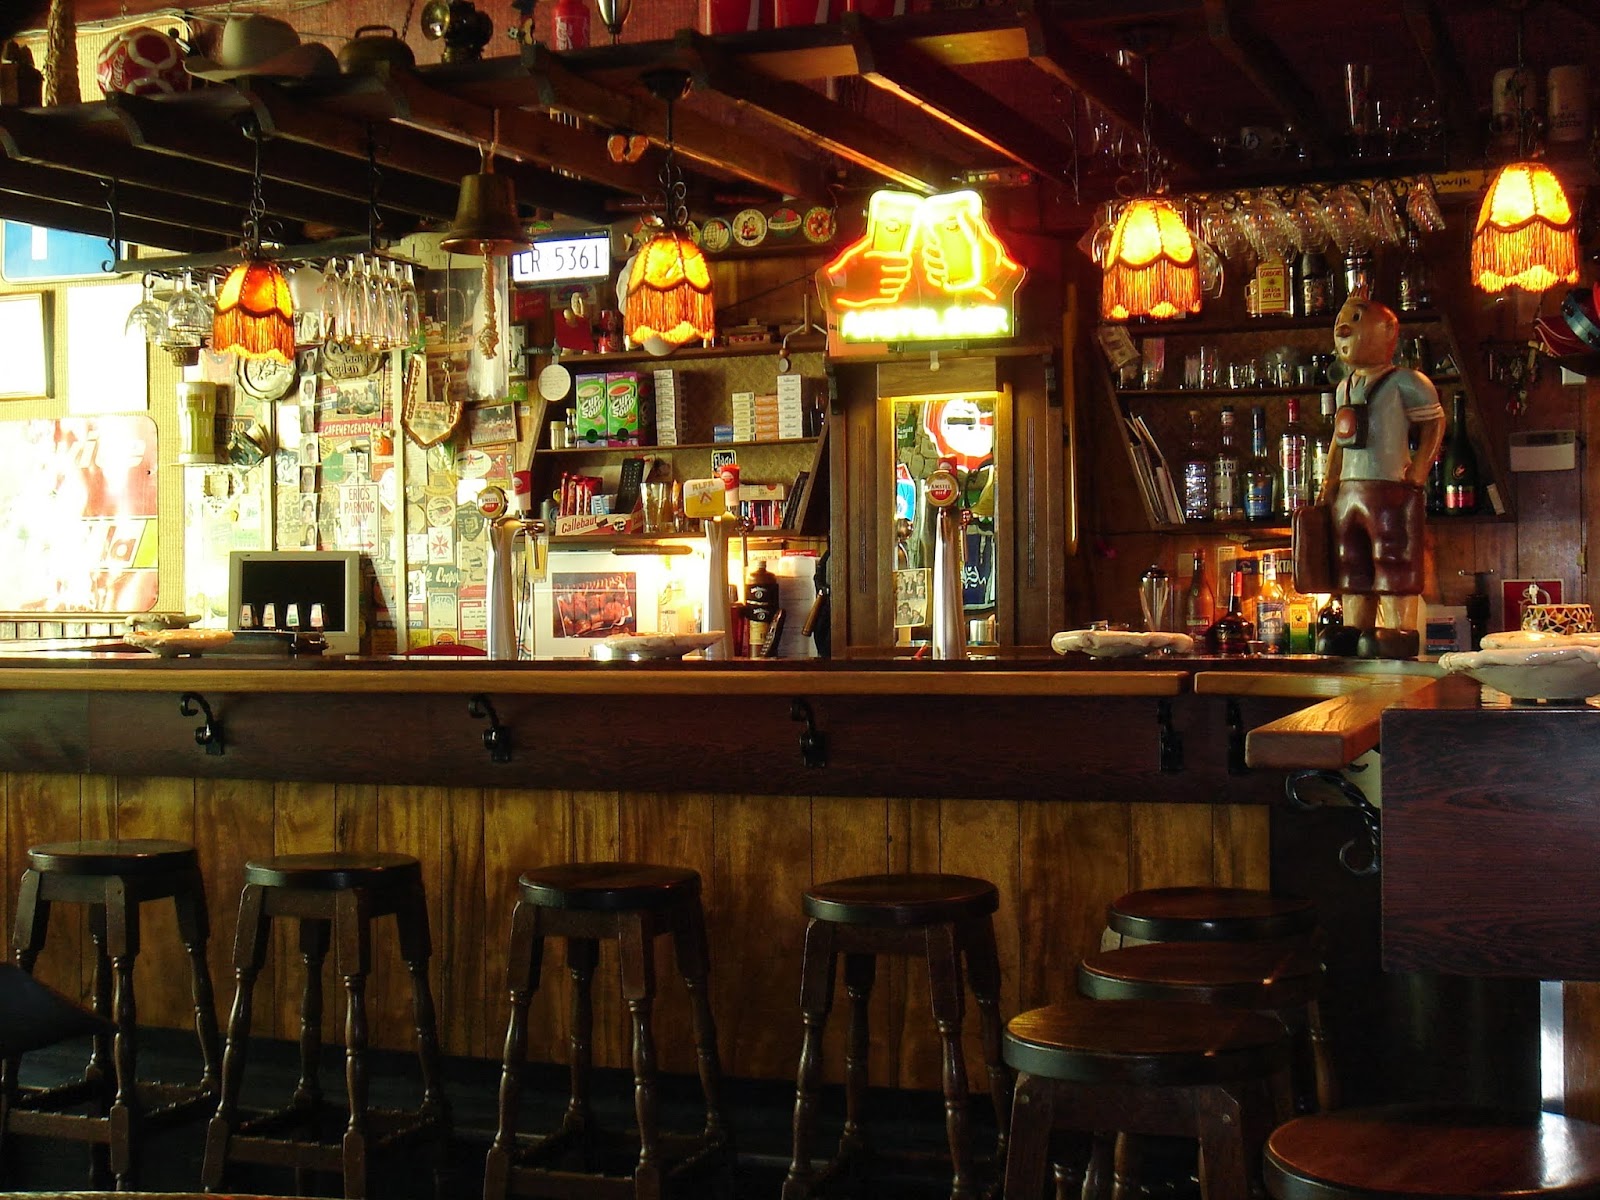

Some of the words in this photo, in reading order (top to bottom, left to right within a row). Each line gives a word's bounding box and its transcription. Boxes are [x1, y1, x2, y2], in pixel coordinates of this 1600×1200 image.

[519, 248, 541, 275] LR
[555, 244, 600, 271] 5361
[582, 395, 600, 411] CUP
[582, 398, 603, 419] SOUP
[612, 394, 631, 410] CUP
[613, 397, 634, 418] SOUP
